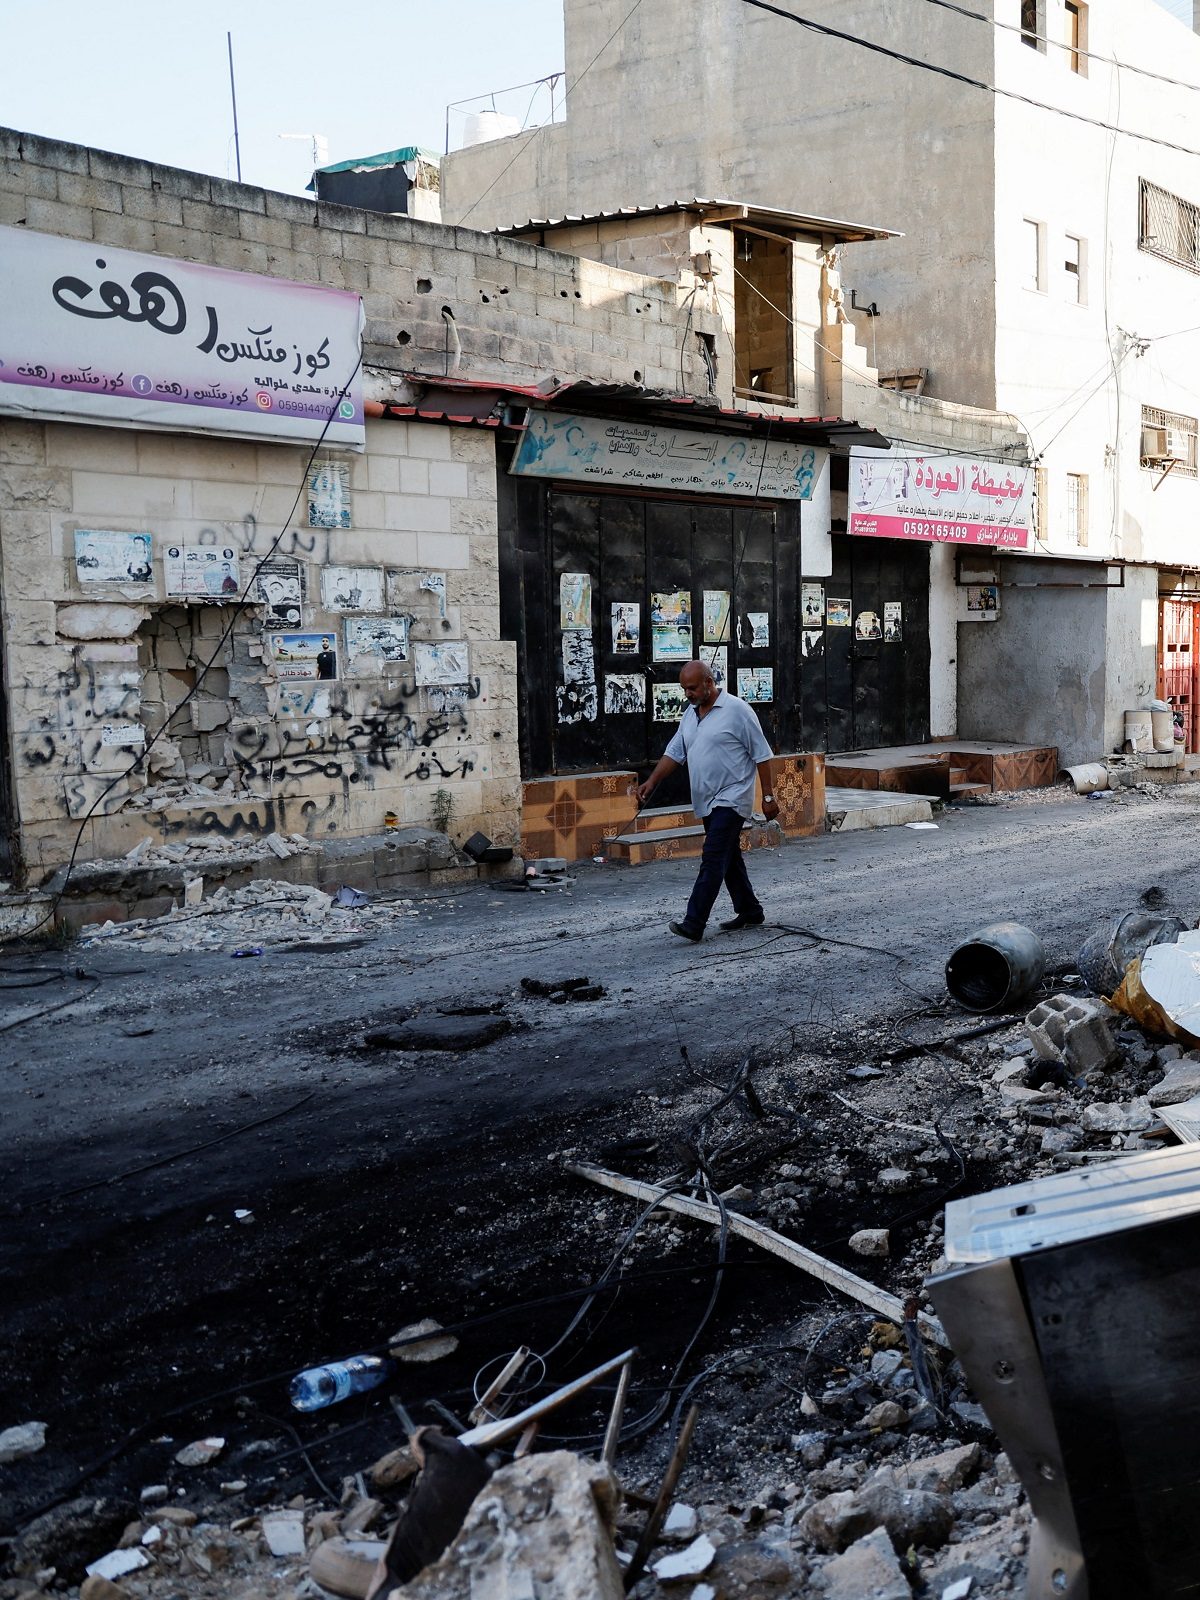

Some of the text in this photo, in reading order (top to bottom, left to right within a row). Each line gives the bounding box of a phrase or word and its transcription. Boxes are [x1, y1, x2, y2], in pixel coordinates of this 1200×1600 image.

[52, 258, 332, 378] كوزمتكس رهف
[914, 457, 1025, 506] مخيطة العودة
[903, 521, 968, 539] 0592165409
